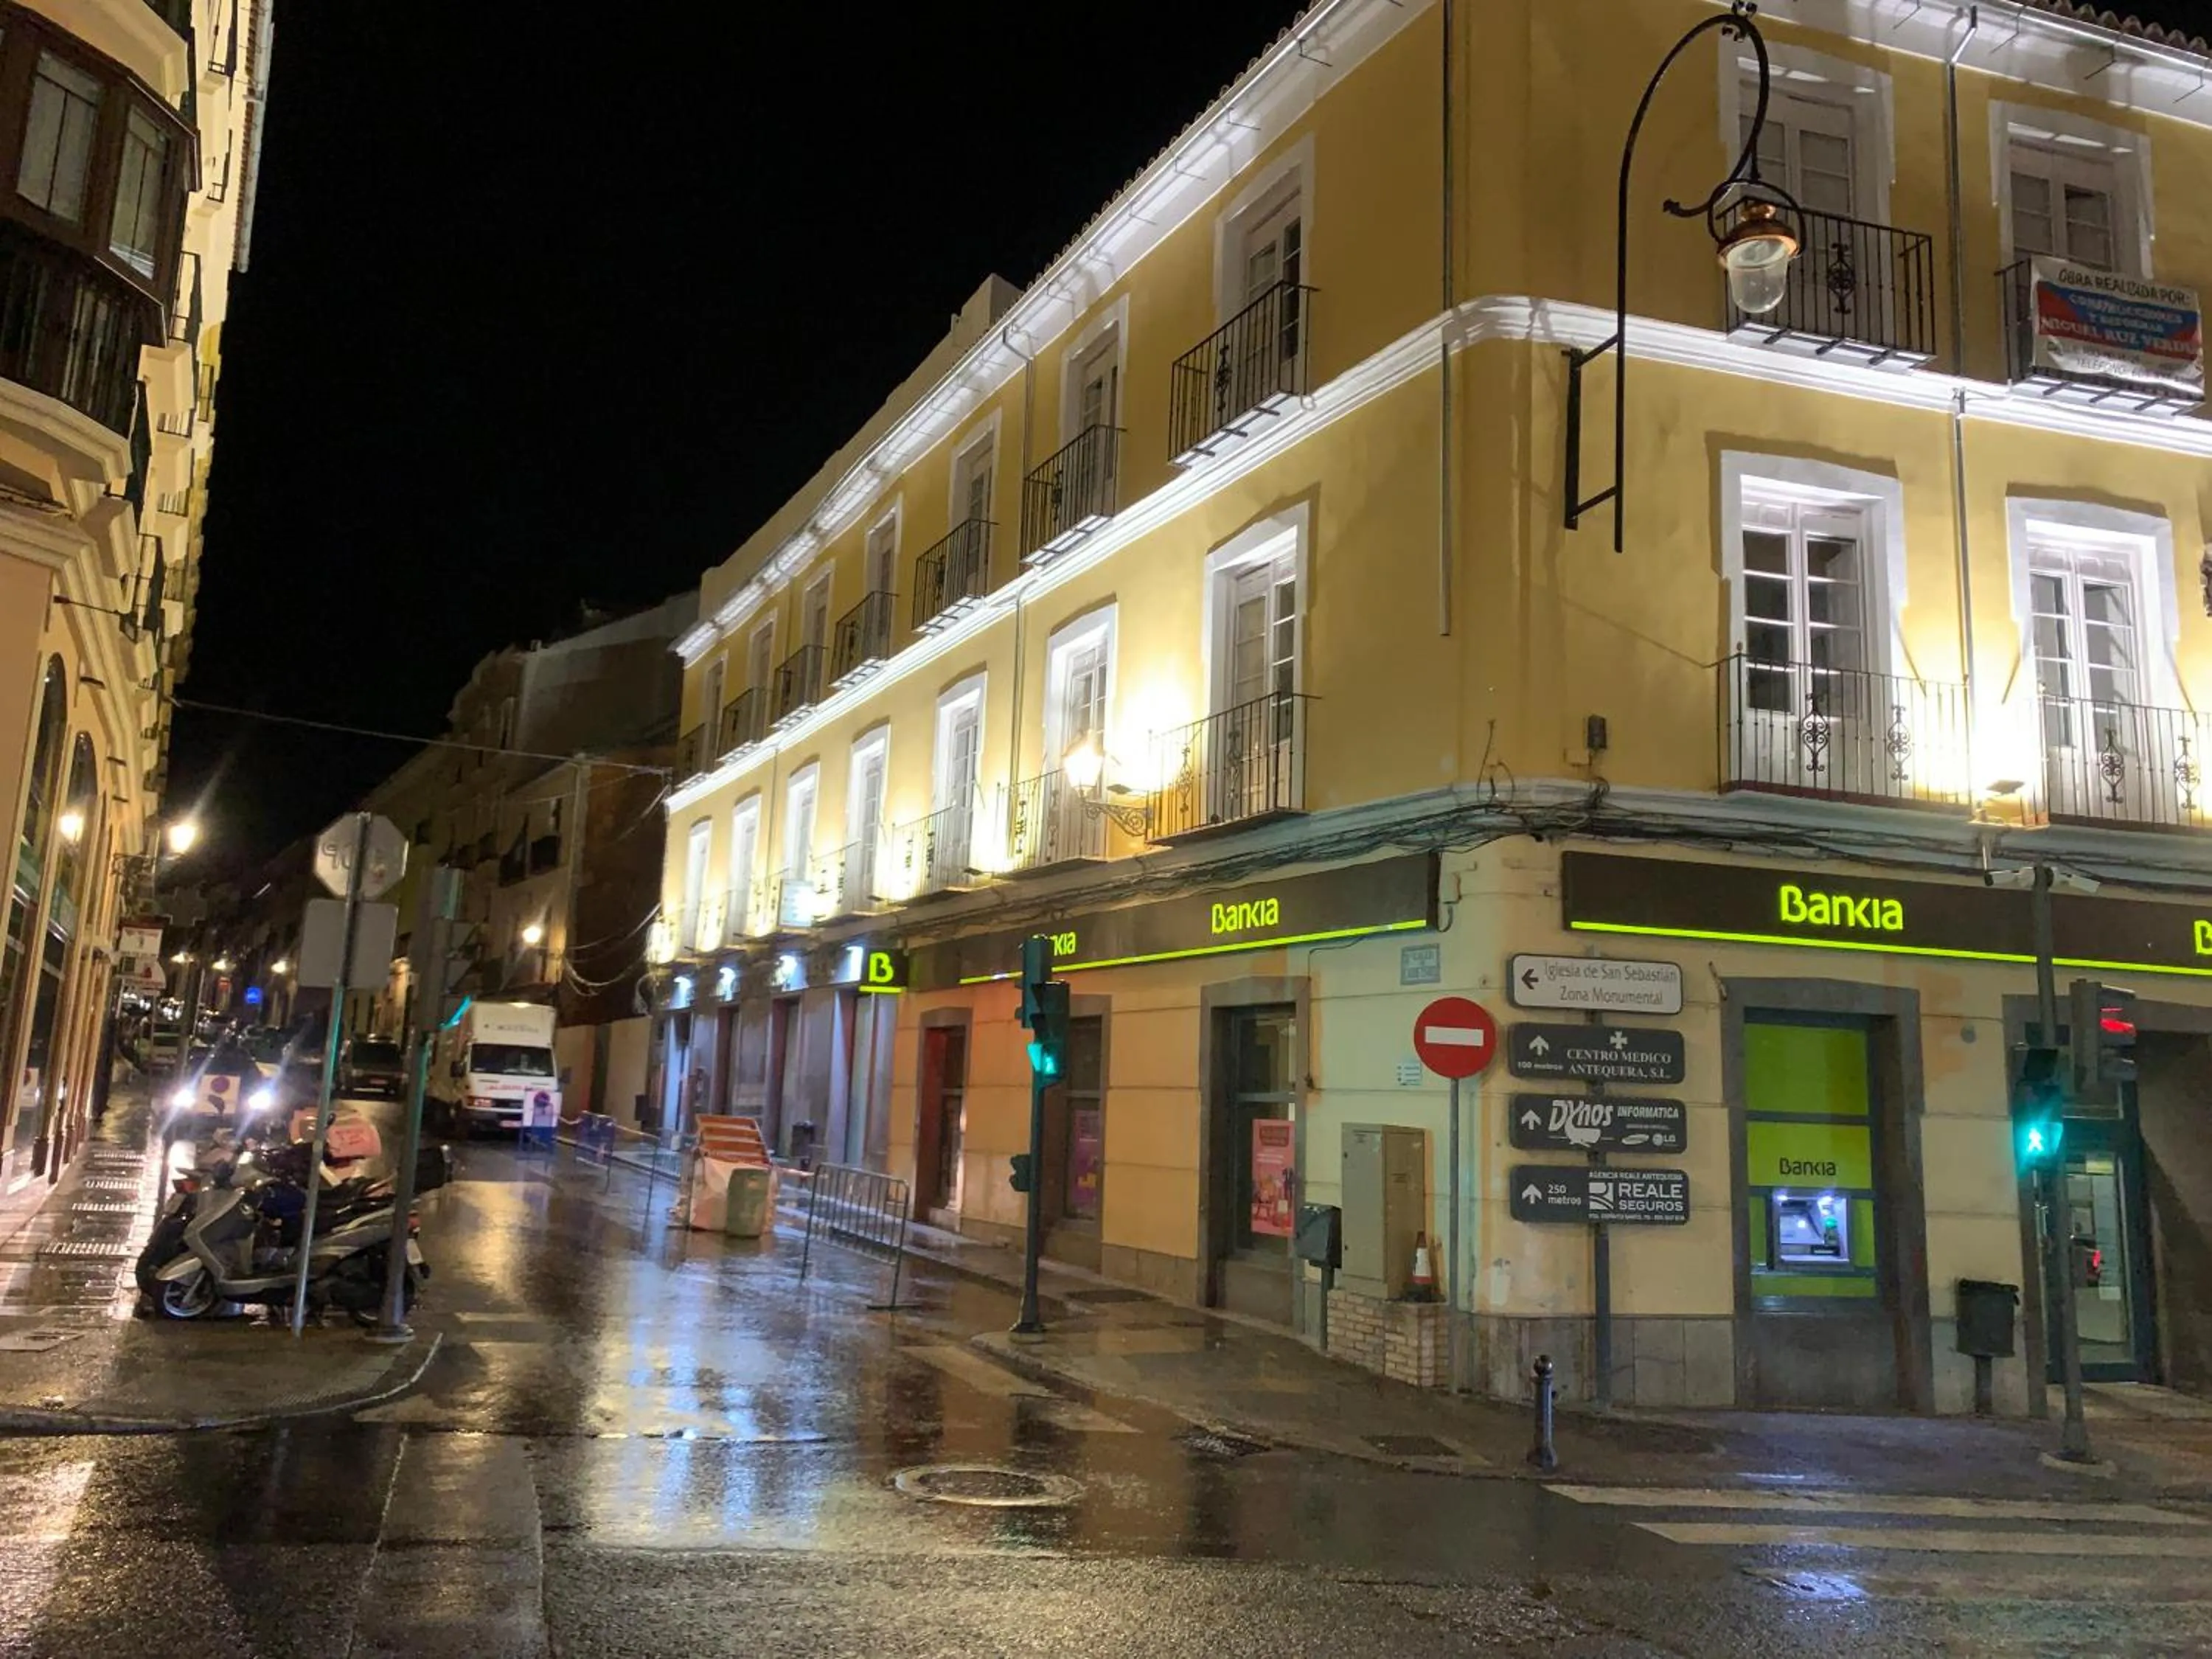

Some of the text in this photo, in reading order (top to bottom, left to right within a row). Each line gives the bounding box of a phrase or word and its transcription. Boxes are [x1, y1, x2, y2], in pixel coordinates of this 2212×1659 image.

[2059, 268, 2092, 285] OBRA
[2096, 276, 2158, 299] REALIZADA
[1211, 897, 1279, 934] Bankia
[1780, 885, 1904, 931] Bankia
[869, 952, 894, 983] B
[1545, 961, 1581, 981] Iglesia
[1583, 964, 1599, 978] de
[1601, 964, 1621, 981] San
[1559, 985, 1664, 1005] Zona Monumental
[1567, 1048, 1618, 1061] CENTRO
[1568, 1064, 1648, 1079] ANTEQUERA,
[1617, 1105, 1680, 1118] INFORMATICA
[1779, 1157, 1836, 1176] Bankia
[1548, 1184, 1567, 1194] 250
[1618, 1182, 1683, 1199] REALE
[1548, 1195, 1582, 1206] metros
[1618, 1200, 1683, 1211] SEGUROS
